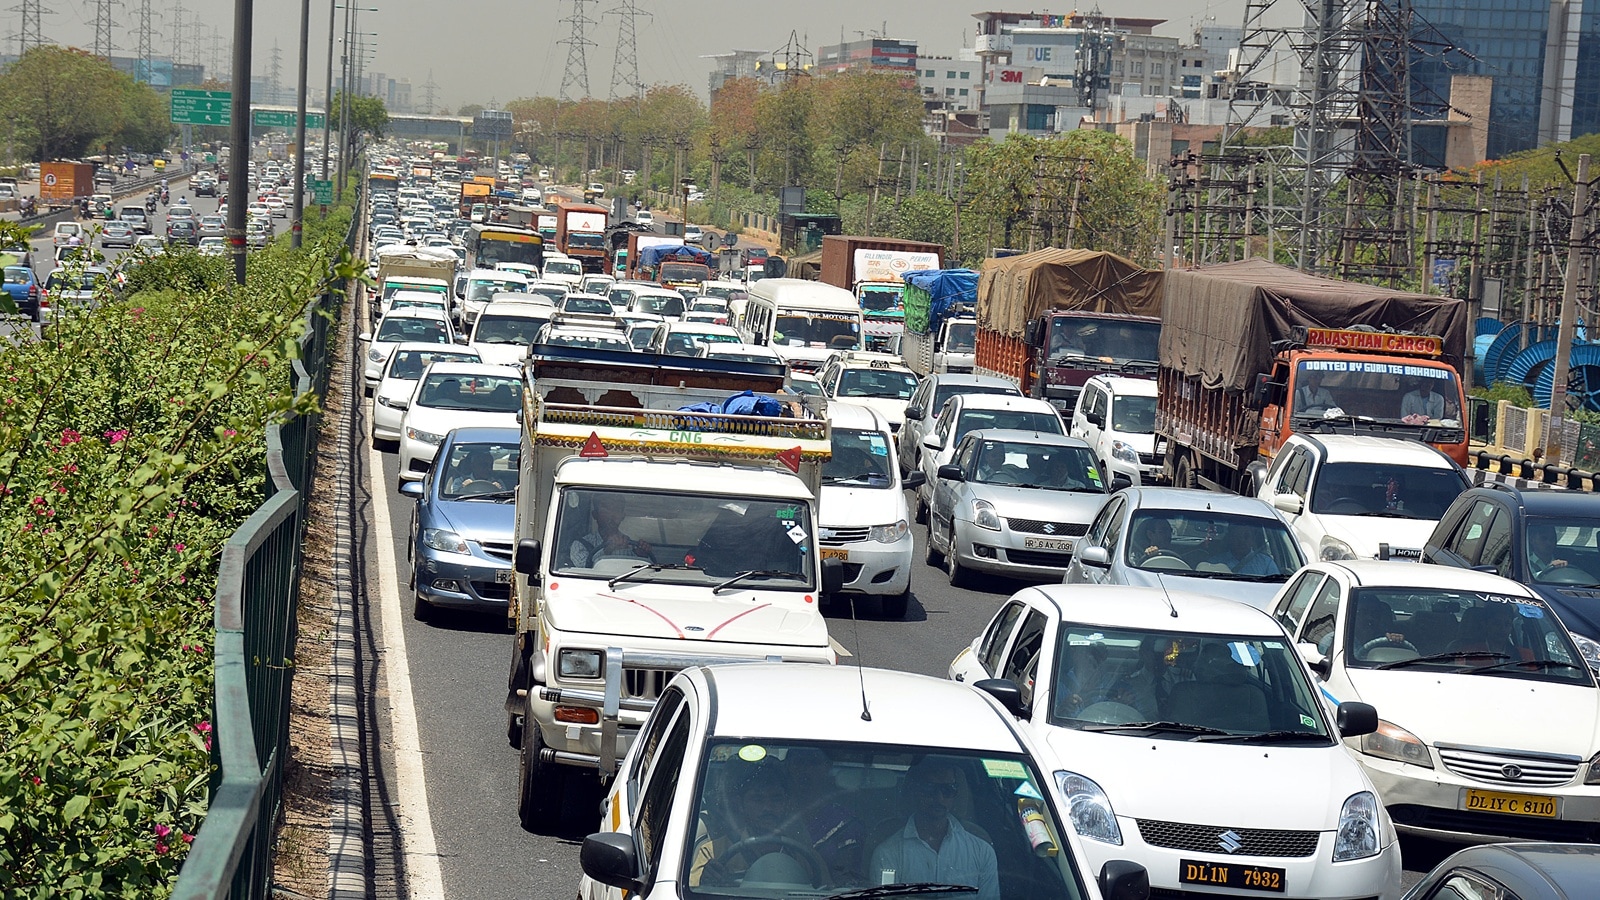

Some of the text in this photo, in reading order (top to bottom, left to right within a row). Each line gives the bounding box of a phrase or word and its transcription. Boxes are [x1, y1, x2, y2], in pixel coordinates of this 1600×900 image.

[1000, 70, 1023, 83] 3M
[1308, 330, 1436, 353] RAJASTHAN CARGO
[1349, 362, 1362, 372] BY
[1364, 363, 1387, 373] GURU
[1404, 366, 1449, 380] BAHADUR
[669, 430, 703, 443] CNG
[1523, 801, 1554, 815] 8110
[1243, 869, 1280, 888] 7932
